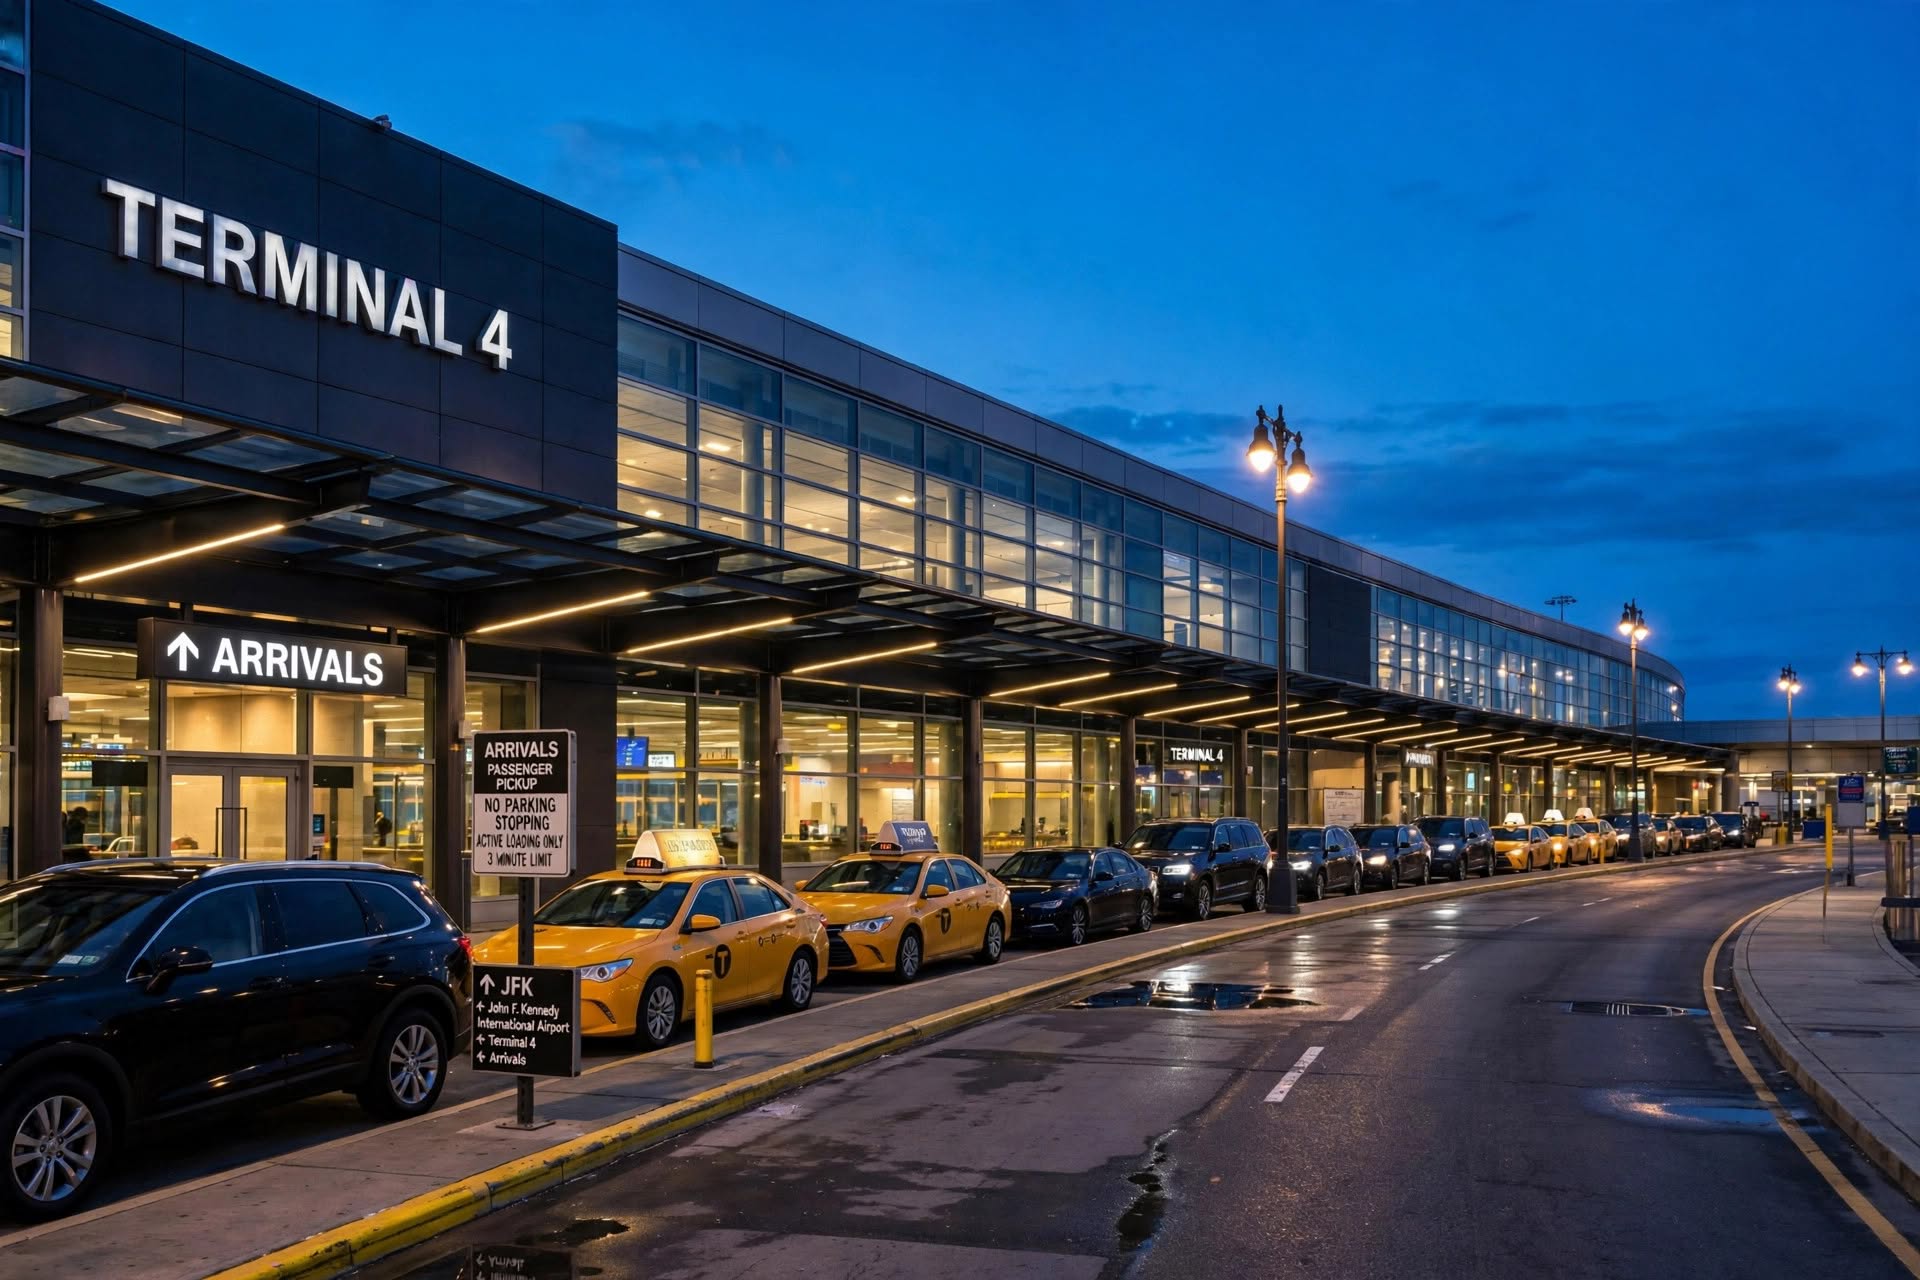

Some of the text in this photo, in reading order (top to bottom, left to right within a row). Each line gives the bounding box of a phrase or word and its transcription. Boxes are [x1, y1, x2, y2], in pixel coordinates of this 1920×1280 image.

[101, 177, 513, 371] TERMINAL 4
[212, 637, 384, 687] ARRIVALS
[484, 741, 559, 758] ARRIVALS
[1170, 747, 1224, 763] TERMINAL 4
[487, 763, 553, 775] PASSENGER
[496, 778, 538, 790] PICKUP
[484, 797, 556, 813] NO PARKING
[495, 815, 550, 830] STOPPING
[476, 834, 564, 849] ACTIVE LOADING ONLY
[487, 852, 553, 867] 3 MINUTE LIMIT
[717, 950, 729, 975] T
[501, 976, 534, 997] JFK
[488, 1001, 560, 1020] John F. Kennedy
[477, 1016, 570, 1036] International Airport
[488, 1034, 537, 1050] Terminal 4
[489, 1051, 527, 1066] Arrivals
